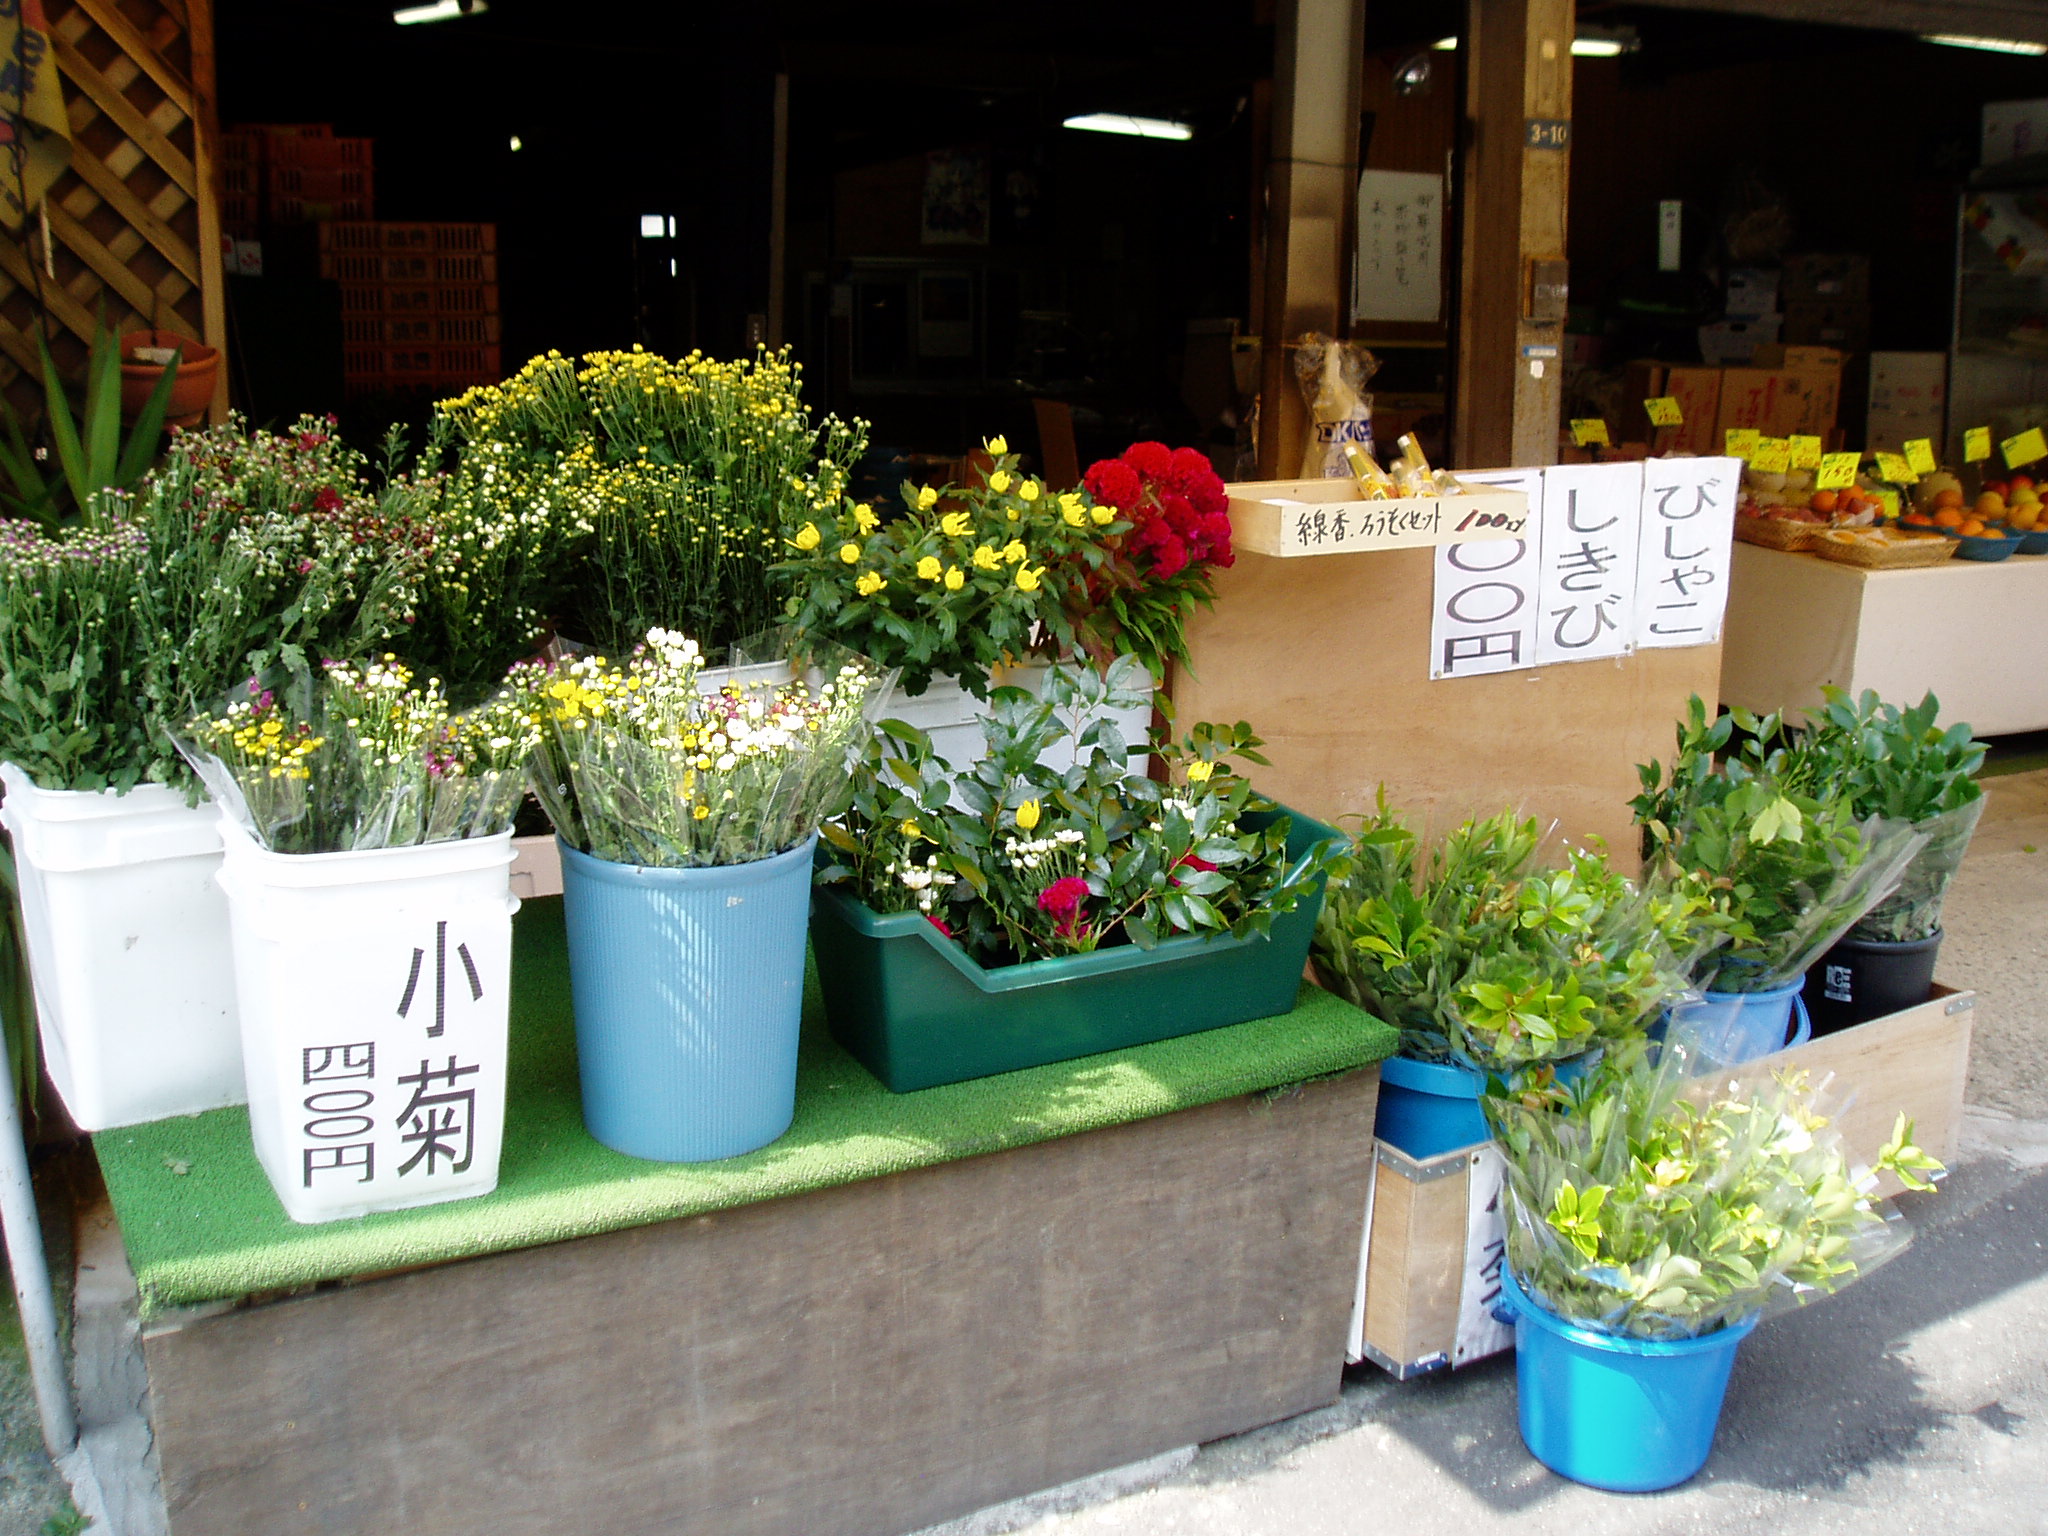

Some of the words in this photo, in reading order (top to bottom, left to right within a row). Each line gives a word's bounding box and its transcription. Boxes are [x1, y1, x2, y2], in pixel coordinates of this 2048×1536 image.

[1531, 124, 1567, 143] 3-10
[1550, 489, 1623, 648] しきび
[396, 920, 483, 1177] 小菊
